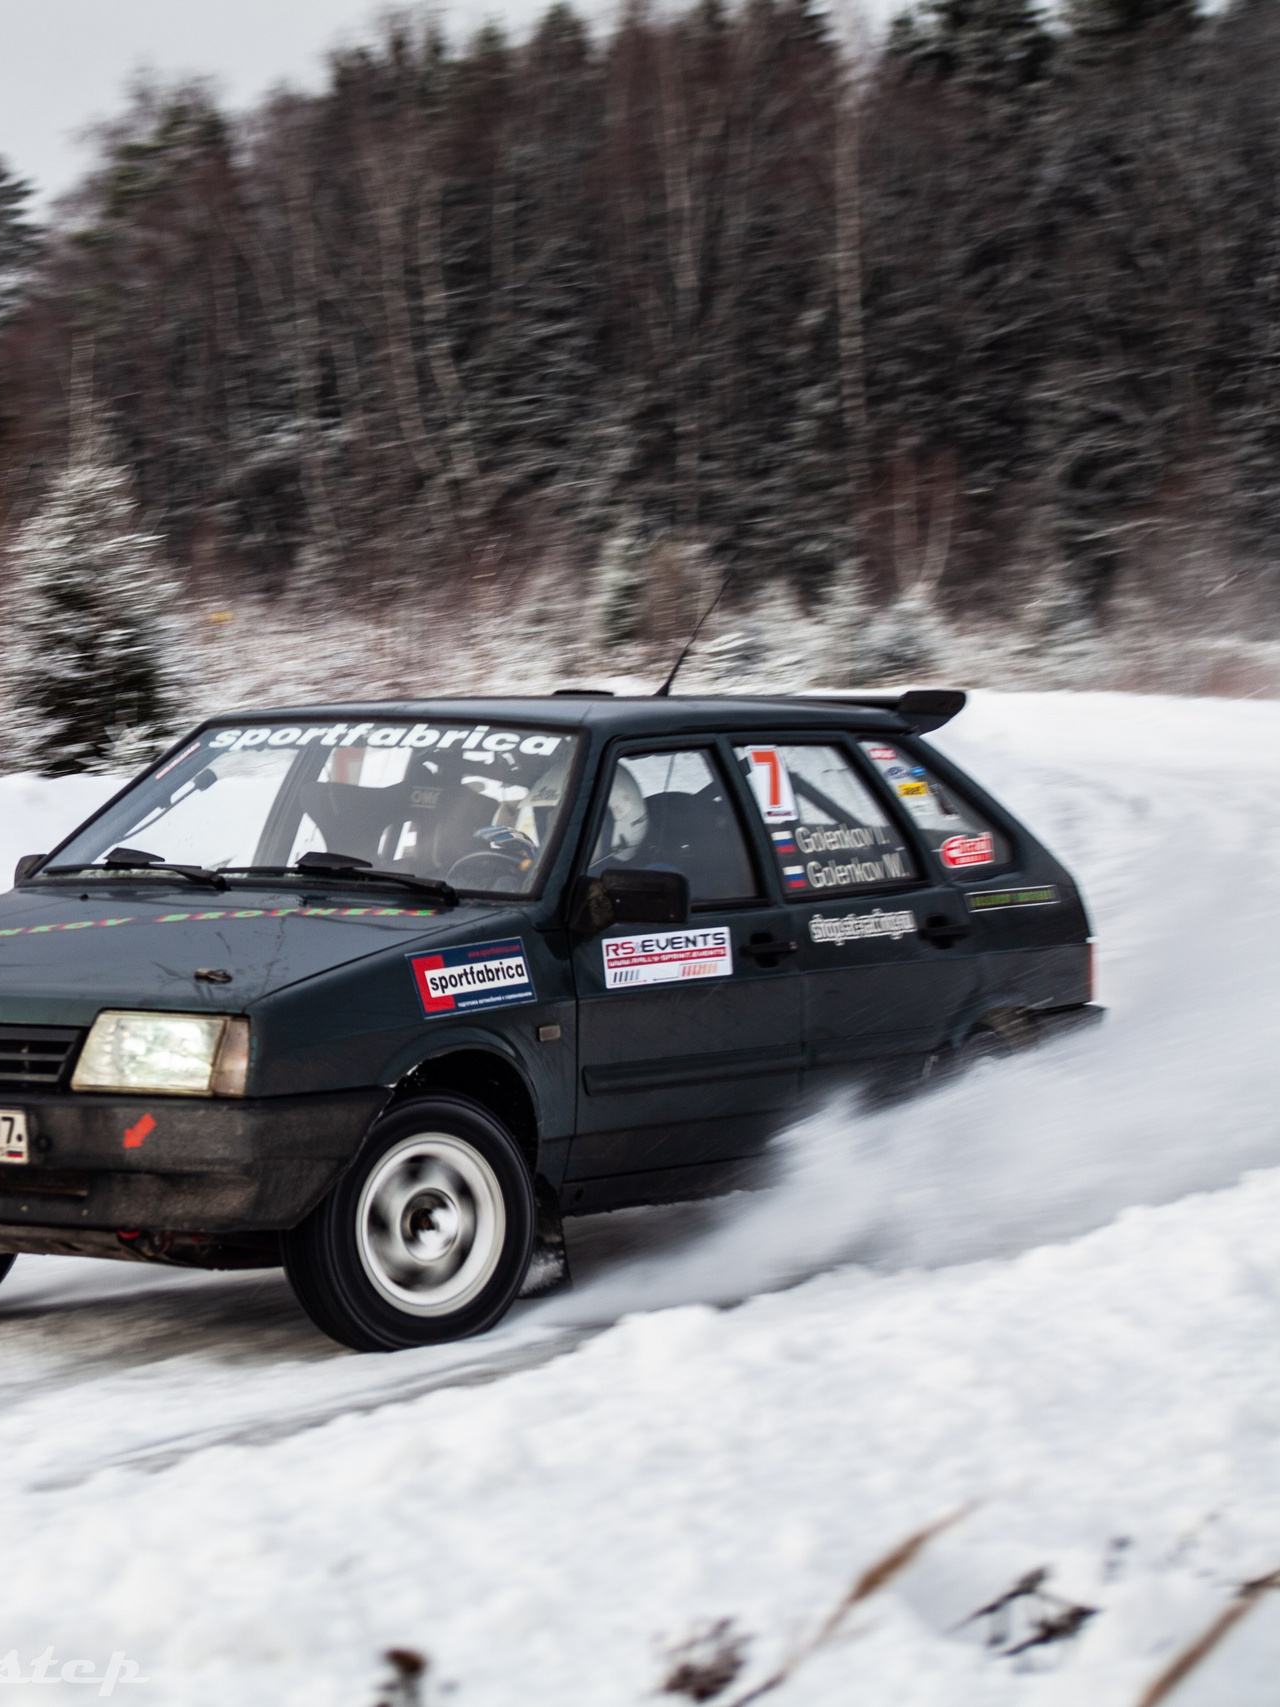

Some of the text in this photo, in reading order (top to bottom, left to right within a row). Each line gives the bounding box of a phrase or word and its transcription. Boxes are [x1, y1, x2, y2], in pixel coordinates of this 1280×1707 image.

[208, 722, 562, 757] sportfabrica
[750, 750, 781, 807] 7
[154, 907, 438, 923] BROTHERS
[605, 932, 726, 957] RS EVENTS
[429, 961, 526, 994] sportfabrica
